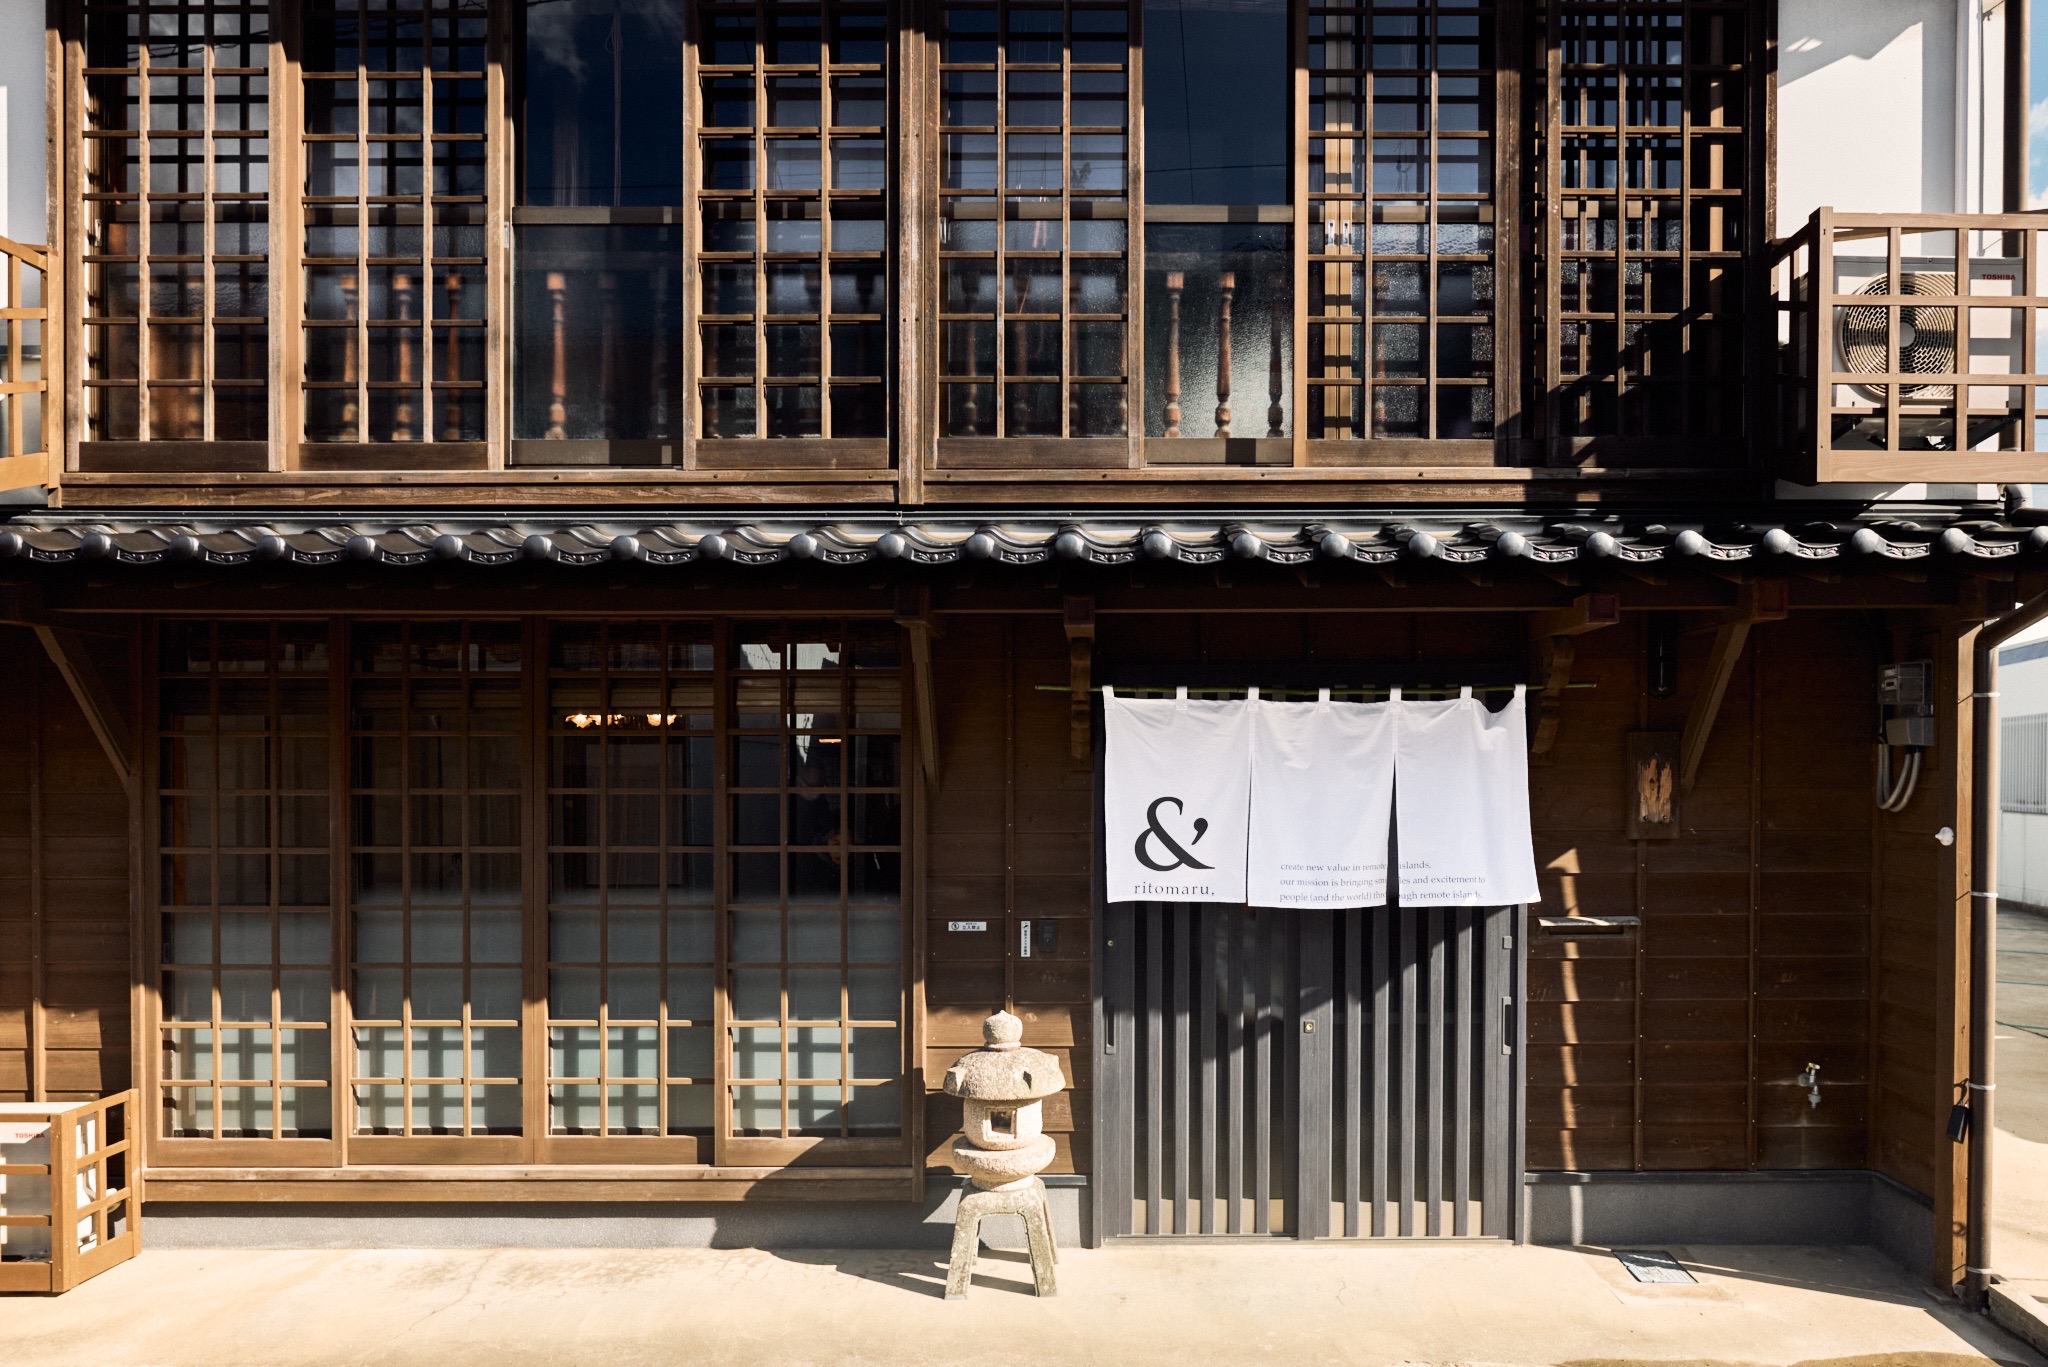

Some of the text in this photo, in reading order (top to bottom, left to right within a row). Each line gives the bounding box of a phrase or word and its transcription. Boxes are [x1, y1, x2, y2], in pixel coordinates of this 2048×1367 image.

[1327, 863, 1351, 872] value
[1362, 863, 1387, 871] remote
[1297, 878, 1329, 887] mission
[1331, 878, 1339, 887] is
[1340, 878, 1374, 888] bringing
[1412, 876, 1429, 884] and
[1430, 876, 1477, 884] excitement
[1478, 876, 1486, 884] to
[1279, 892, 1308, 903] people
[1309, 893, 1329, 902] (and
[1331, 892, 1345, 902] the
[1346, 891, 1372, 901] world)
